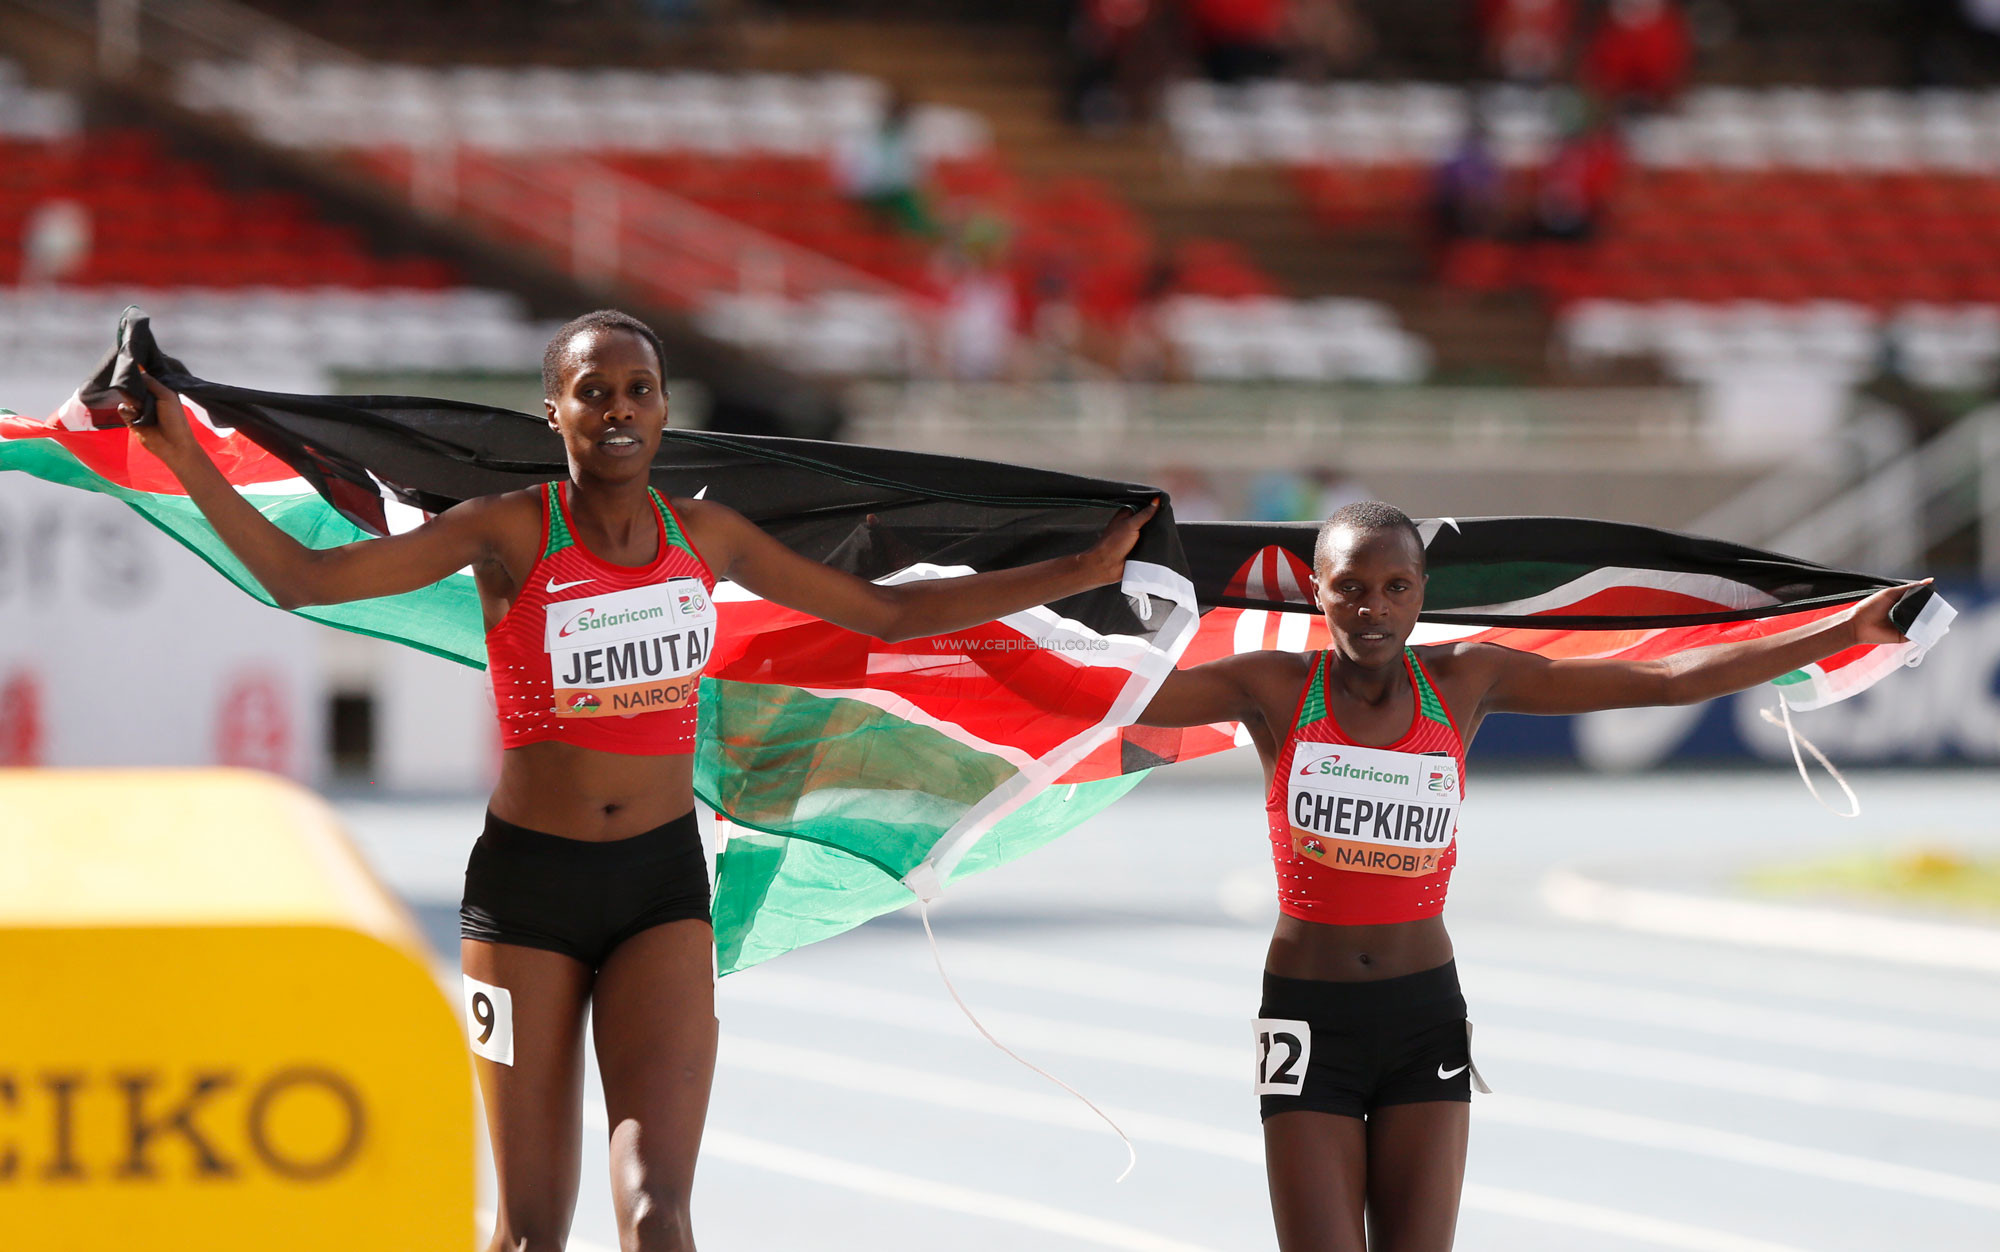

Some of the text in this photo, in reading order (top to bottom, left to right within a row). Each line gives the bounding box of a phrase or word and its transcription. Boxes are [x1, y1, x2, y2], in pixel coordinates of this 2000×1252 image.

[578, 606, 664, 631] Safaricom
[562, 627, 709, 684] JEMUTAI
[1320, 761, 1410, 785] Safaricom
[1295, 791, 1451, 843] CHEPKIRUI
[1336, 847, 1420, 872] NAIROBI
[472, 991, 495, 1045] 9
[1260, 1031, 1302, 1085] 12
